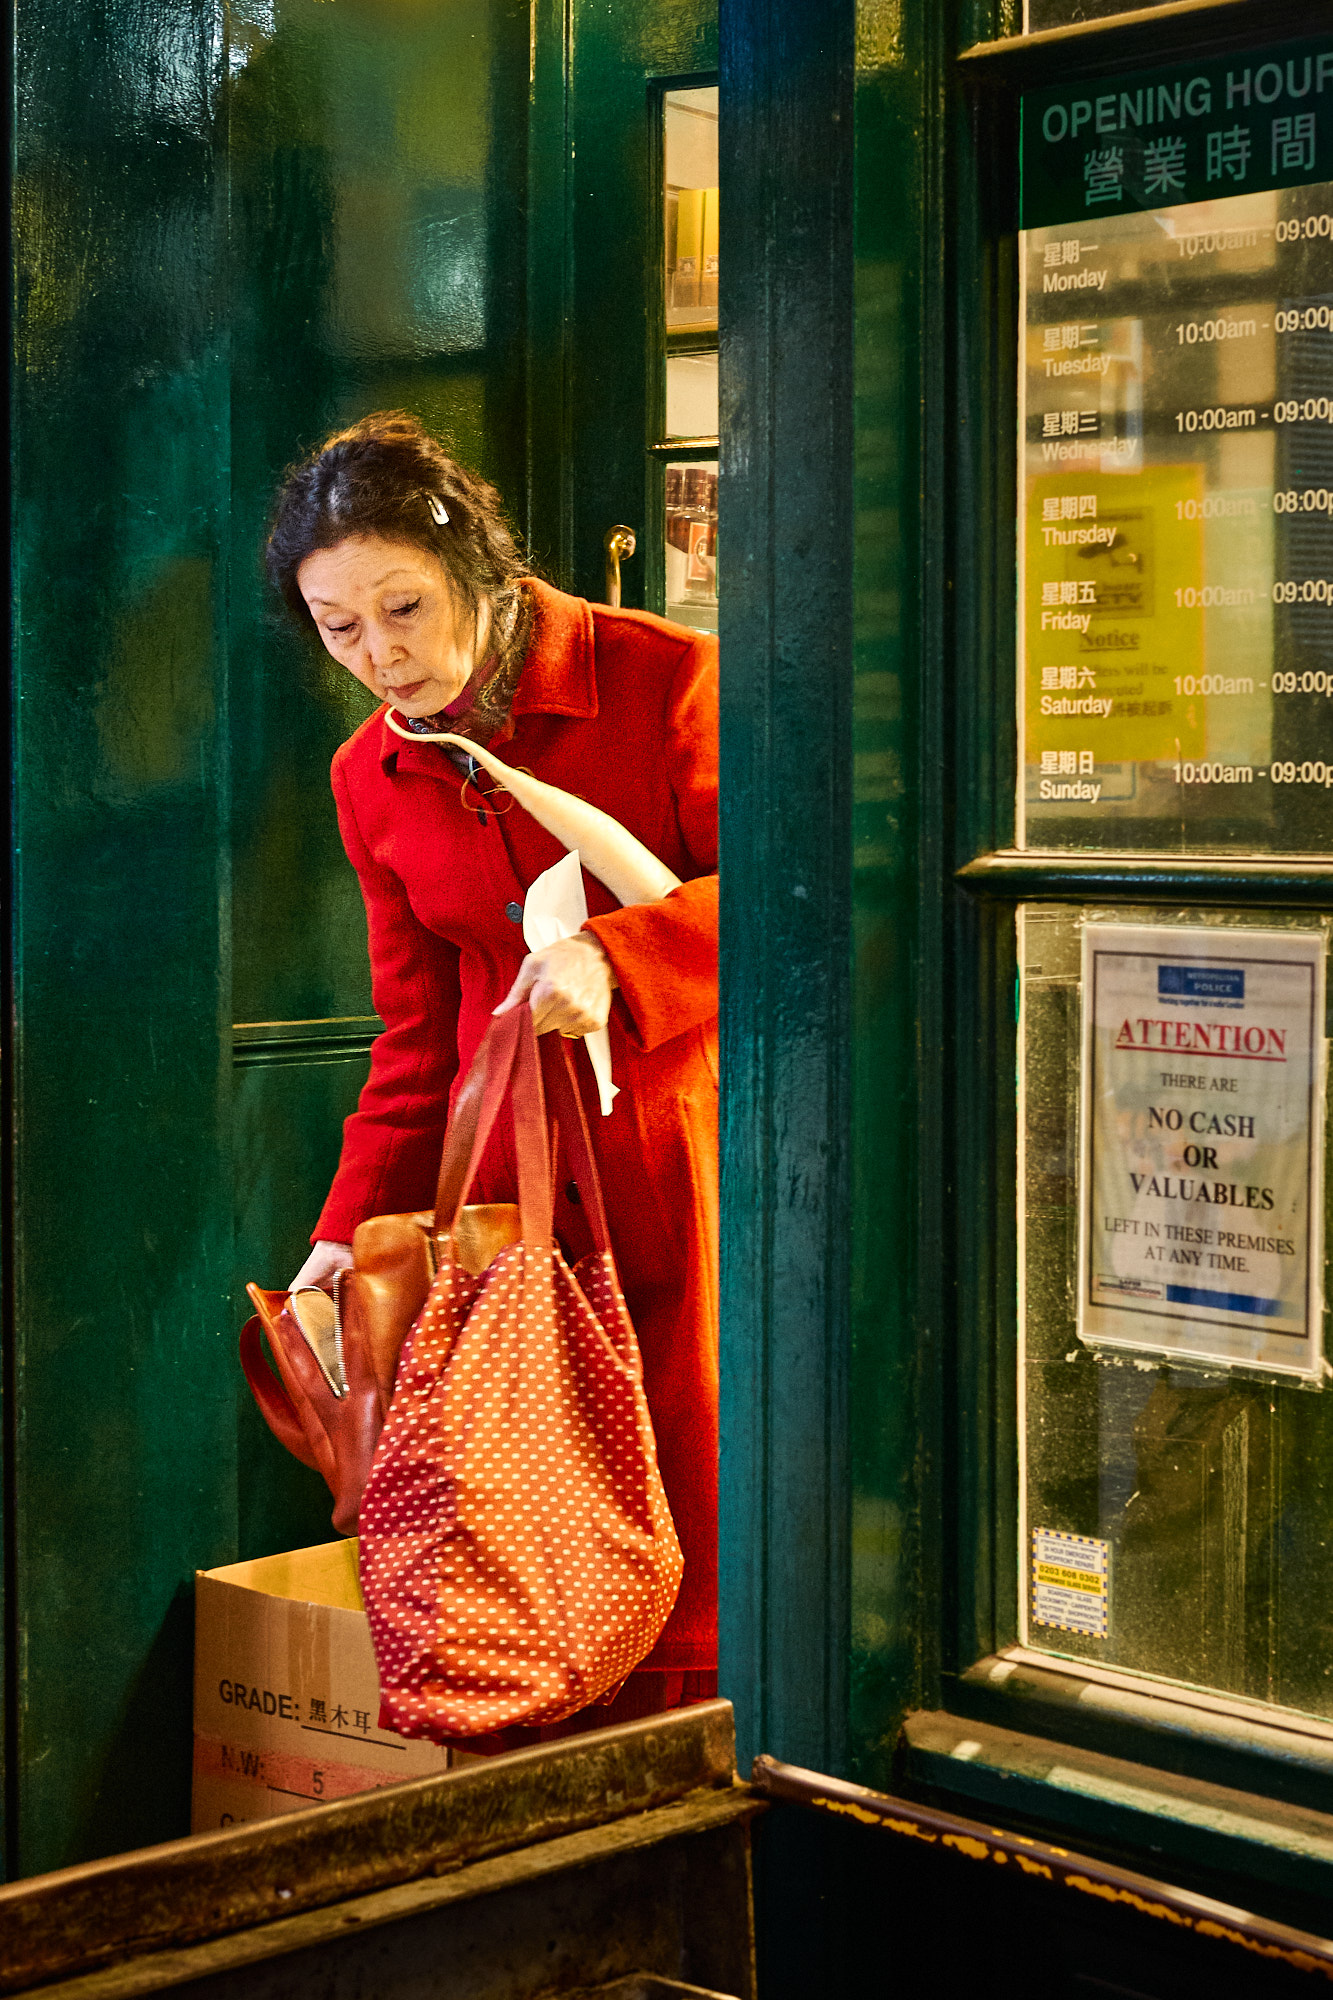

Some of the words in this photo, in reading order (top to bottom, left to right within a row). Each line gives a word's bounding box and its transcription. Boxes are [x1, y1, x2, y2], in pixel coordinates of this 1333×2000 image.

[1042, 77, 1211, 142] OPENING
[1083, 112, 1316, 206] 營業時間
[1275, 214, 1333, 243] 09:00
[1043, 239, 1099, 268] 星期一
[1043, 268, 1107, 293] Monday
[1043, 324, 1099, 353] 星期二
[1175, 318, 1256, 345] 10:00am
[1042, 353, 1111, 377] Tuesday
[1042, 410, 1098, 437] 星期三
[1175, 407, 1256, 433] 10:00am
[1041, 436, 1137, 462] Wednesday
[1041, 495, 1097, 521] 星期四
[1174, 496, 1253, 520] 10:00am
[1041, 524, 1117, 547] Thursday
[1041, 581, 1097, 606] 星期五
[1174, 585, 1253, 608] 10:00am
[1041, 610, 1091, 633] Friday
[1080, 629, 1140, 648] Notice
[1041, 665, 1096, 690] 星期六
[1173, 674, 1253, 696] 10:00am
[1040, 695, 1112, 718] Saturday
[1040, 750, 1095, 775] 星期日
[1172, 762, 1253, 785] 10:00am
[1039, 781, 1101, 803] Sunday
[1193, 982, 1233, 993] POLICE
[1116, 1018, 1287, 1055] ATTENTION
[1160, 1073, 1205, 1090] THERE
[1209, 1076, 1239, 1092] ARE
[1149, 1106, 1183, 1131] NO
[1189, 1110, 1255, 1138] CASH
[1183, 1145, 1219, 1169] OR
[1129, 1173, 1275, 1211] VALUABLES
[1104, 1216, 1141, 1235] LEFT
[1144, 1221, 1160, 1237] IN
[1164, 1224, 1213, 1245] THESE
[1217, 1232, 1295, 1255] PREMISES
[1144, 1246, 1165, 1260] AT
[1170, 1249, 1203, 1266] ANY
[1207, 1252, 1250, 1273] TIME.
[1039, 1565, 1059, 1575] 0203
[1062, 1570, 1077, 1579] 608
[1079, 1573, 1100, 1584] 0302
[219, 1679, 300, 1721] GRADE:
[309, 1698, 372, 1734] 黑木耳
[312, 1771, 324, 1795] 5
